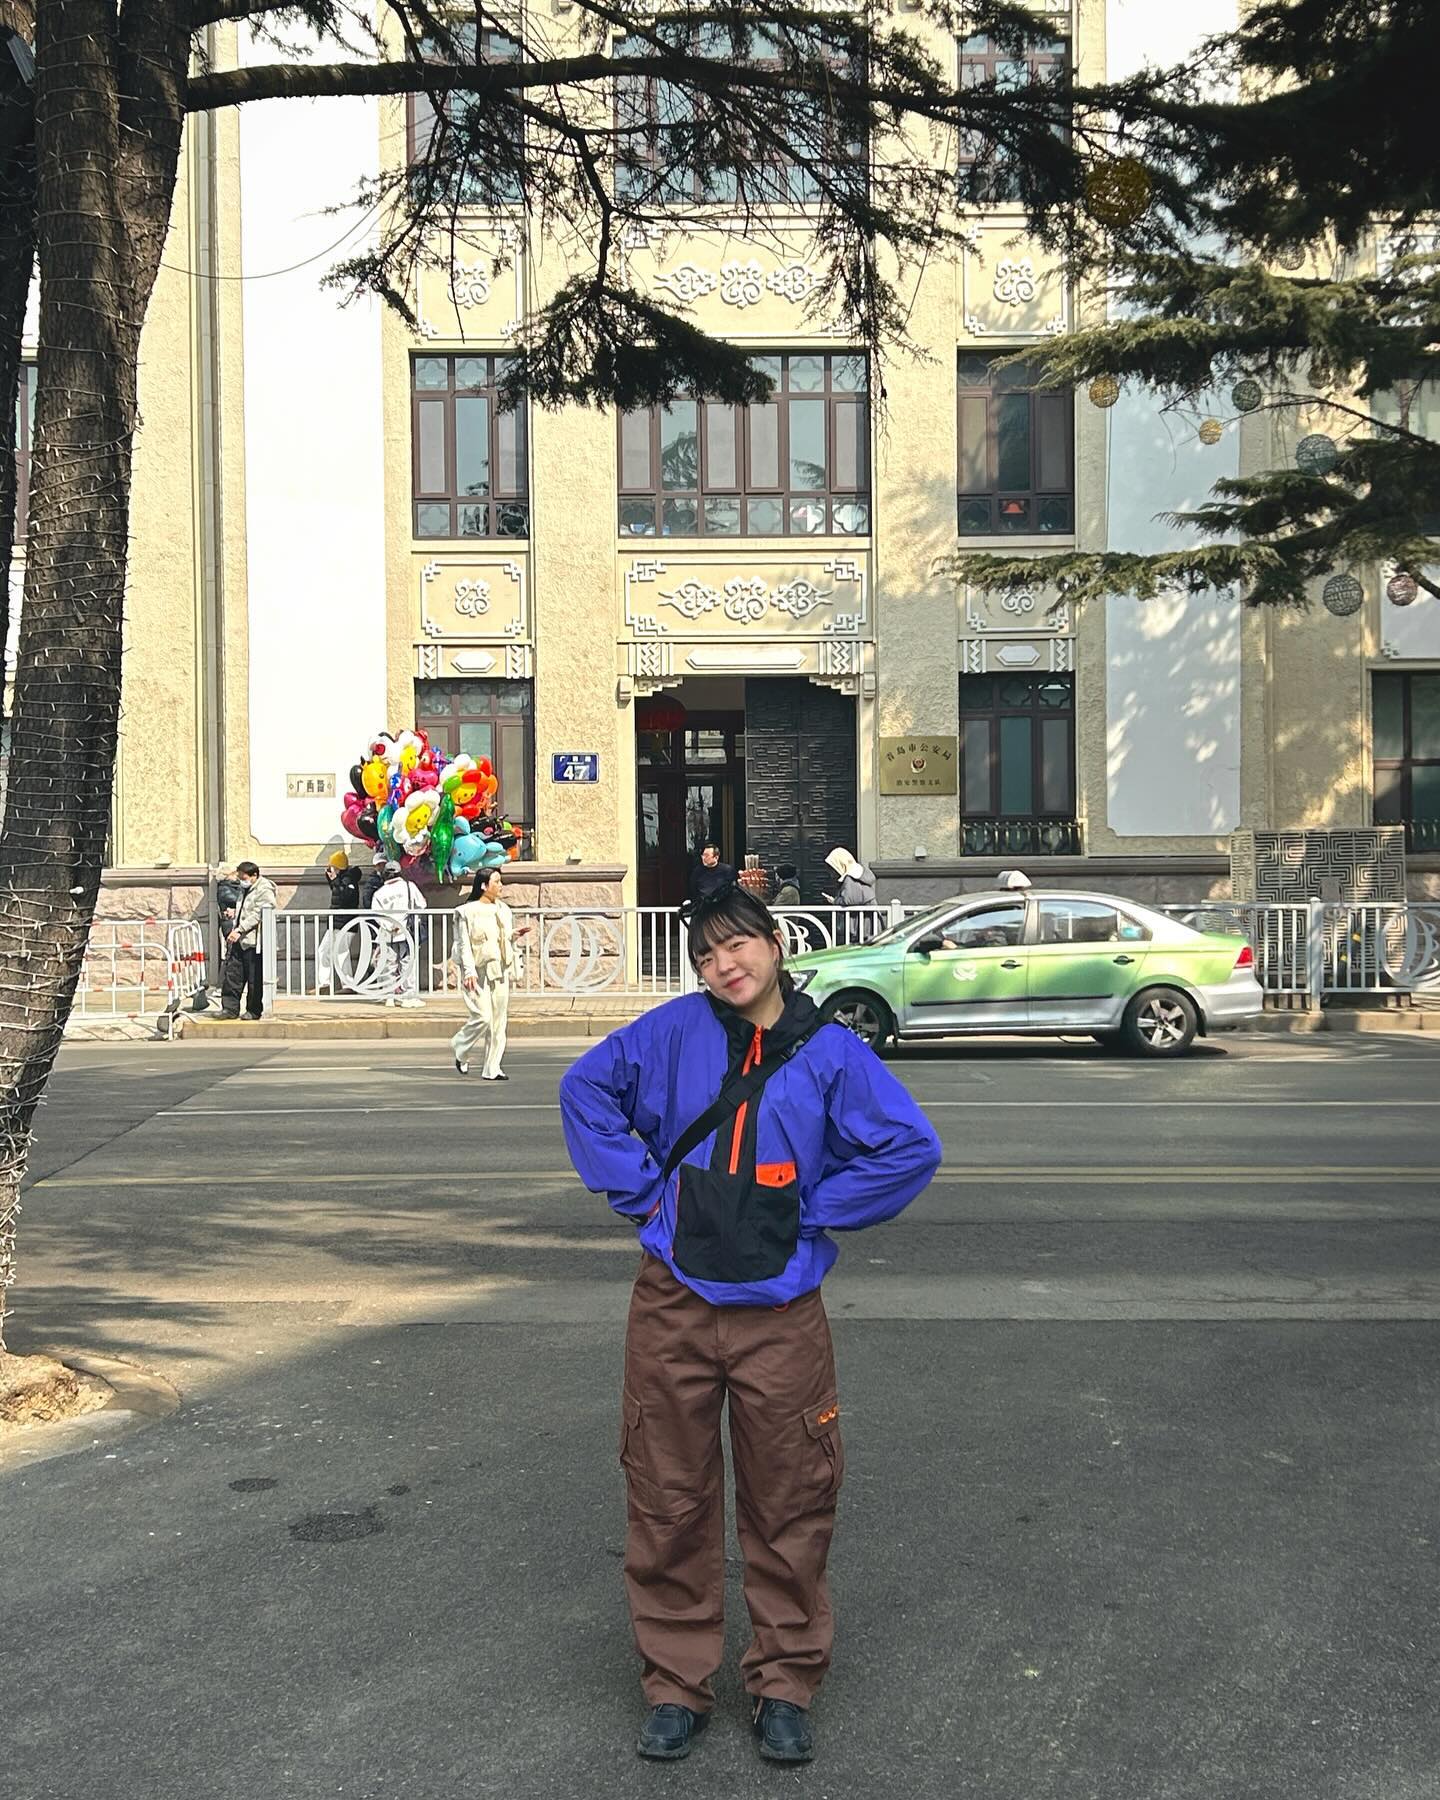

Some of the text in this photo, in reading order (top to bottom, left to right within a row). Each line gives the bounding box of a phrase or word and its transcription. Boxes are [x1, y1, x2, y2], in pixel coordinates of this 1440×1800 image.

[886, 743, 952, 762] 青岛市公安局
[563, 765, 588, 780] 47
